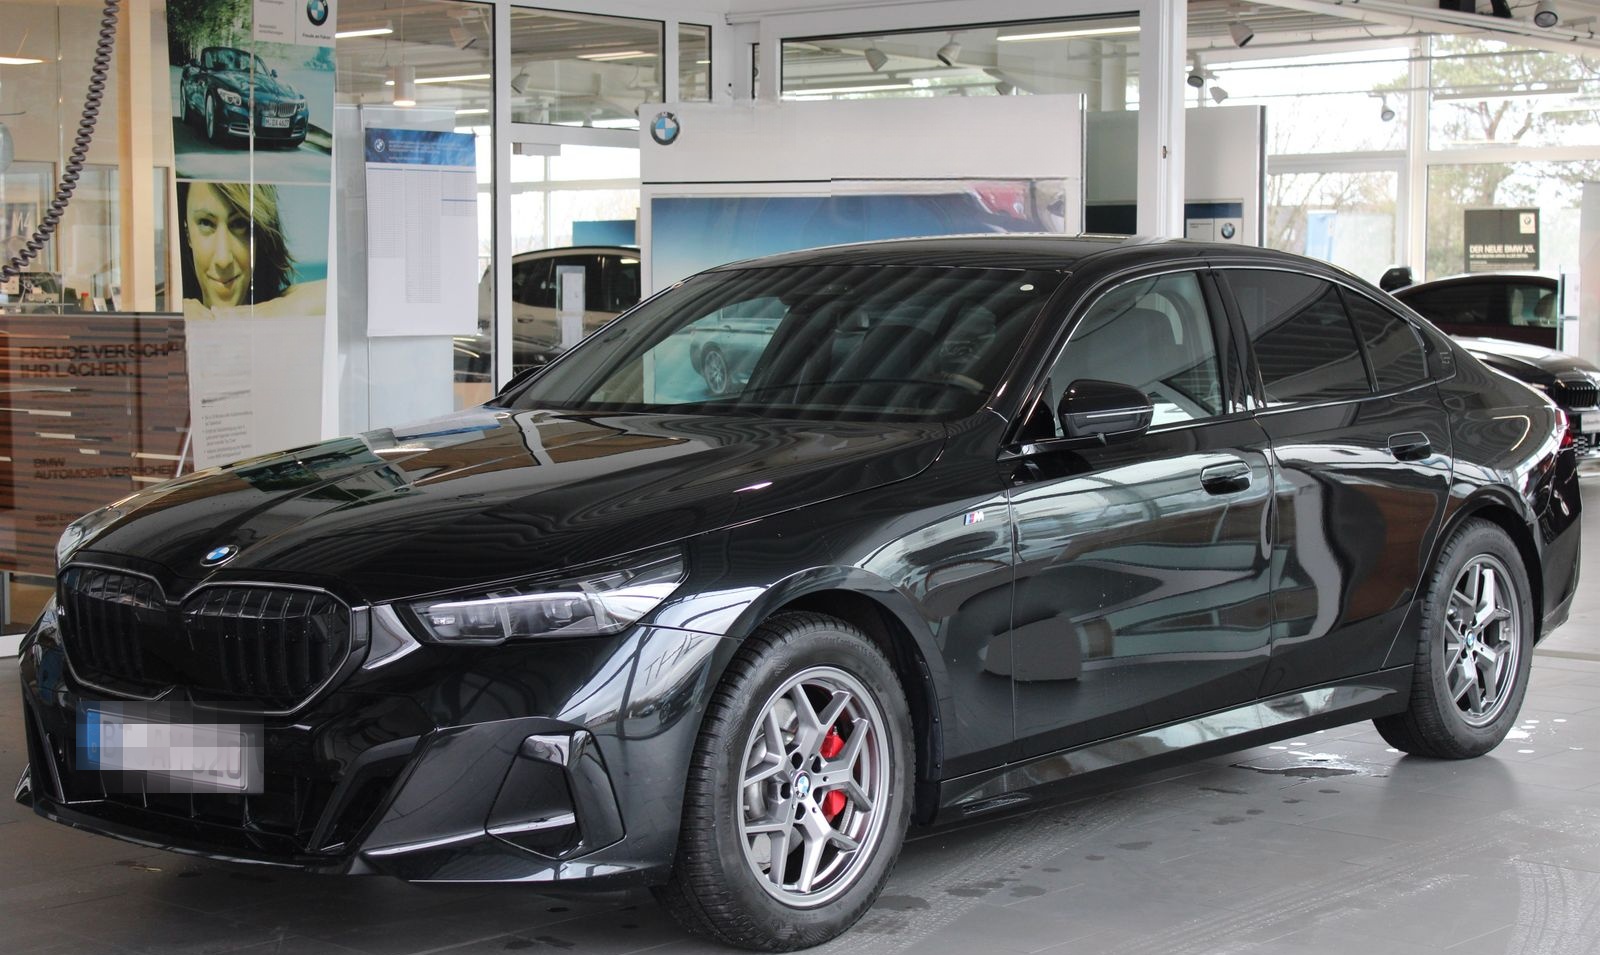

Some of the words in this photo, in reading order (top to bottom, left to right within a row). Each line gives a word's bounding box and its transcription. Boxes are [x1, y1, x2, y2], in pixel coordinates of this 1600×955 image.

[1469, 244, 1484, 254] DER
[1484, 244, 1504, 254] NEUE
[1504, 244, 1524, 254] BMW
[20, 344, 91, 360] FREUDE
[20, 362, 51, 379] IHR
